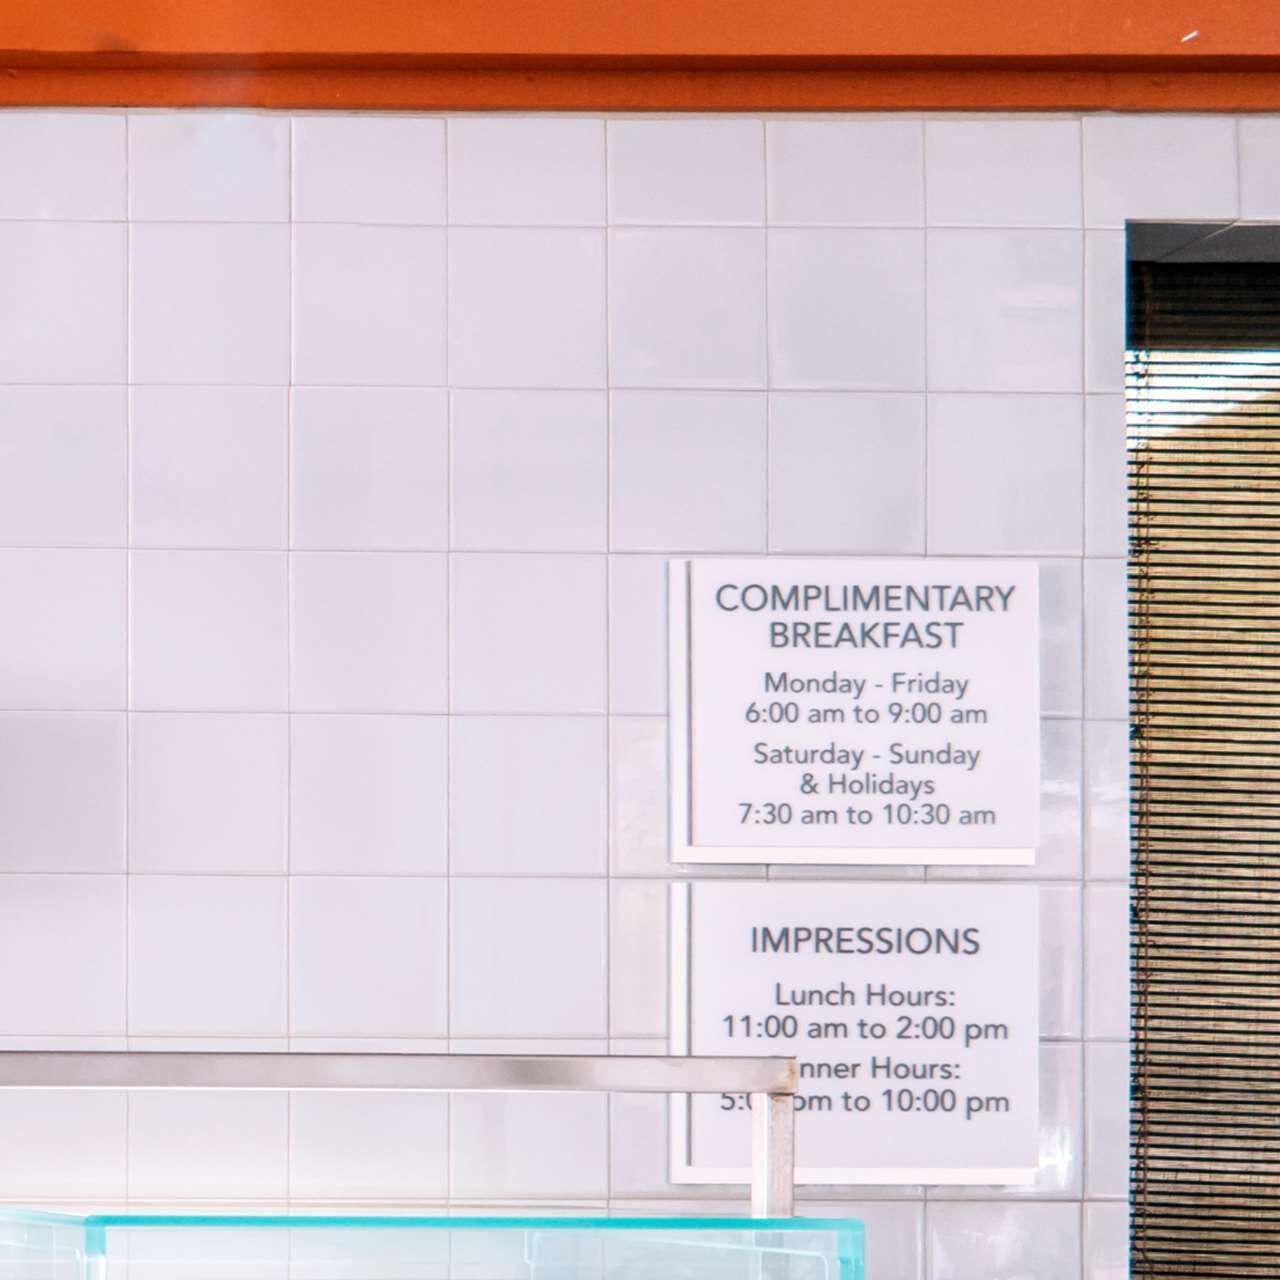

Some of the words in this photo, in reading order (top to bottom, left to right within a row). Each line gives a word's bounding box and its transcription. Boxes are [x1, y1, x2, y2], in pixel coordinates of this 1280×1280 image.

[715, 583, 1016, 612] COMPLIMENTARY
[769, 621, 965, 650] BREAKFAST
[764, 671, 867, 701] Monday
[892, 671, 969, 701] Friday
[745, 701, 800, 724] 6:00
[807, 708, 845, 724] am
[852, 705, 880, 724] to
[888, 702, 942, 724] 9:00
[950, 708, 988, 724] am
[754, 742, 865, 771] Saturday
[889, 742, 981, 772] Sunday
[799, 773, 819, 795] &
[828, 772, 935, 801] Holidays
[738, 802, 793, 825] 7:30
[800, 809, 838, 825] am
[845, 806, 873, 825] to
[882, 803, 951, 825] 10:30
[958, 809, 996, 825] am
[751, 926, 981, 956] IMPRESSIONS
[775, 982, 856, 1007] Lunch
[866, 983, 955, 1008] Hours:
[722, 1014, 799, 1039] 11:00
[807, 1022, 849, 1039] am
[856, 1018, 887, 1040] to
[895, 1015, 956, 1040] 2:00
[964, 1023, 1009, 1049] pm
[799, 1062, 862, 1080] nner
[871, 1056, 961, 1080] Hours:
[840, 1091, 871, 1112] to
[882, 1088, 957, 1113] 10:00
[965, 1095, 1010, 1121] pm
